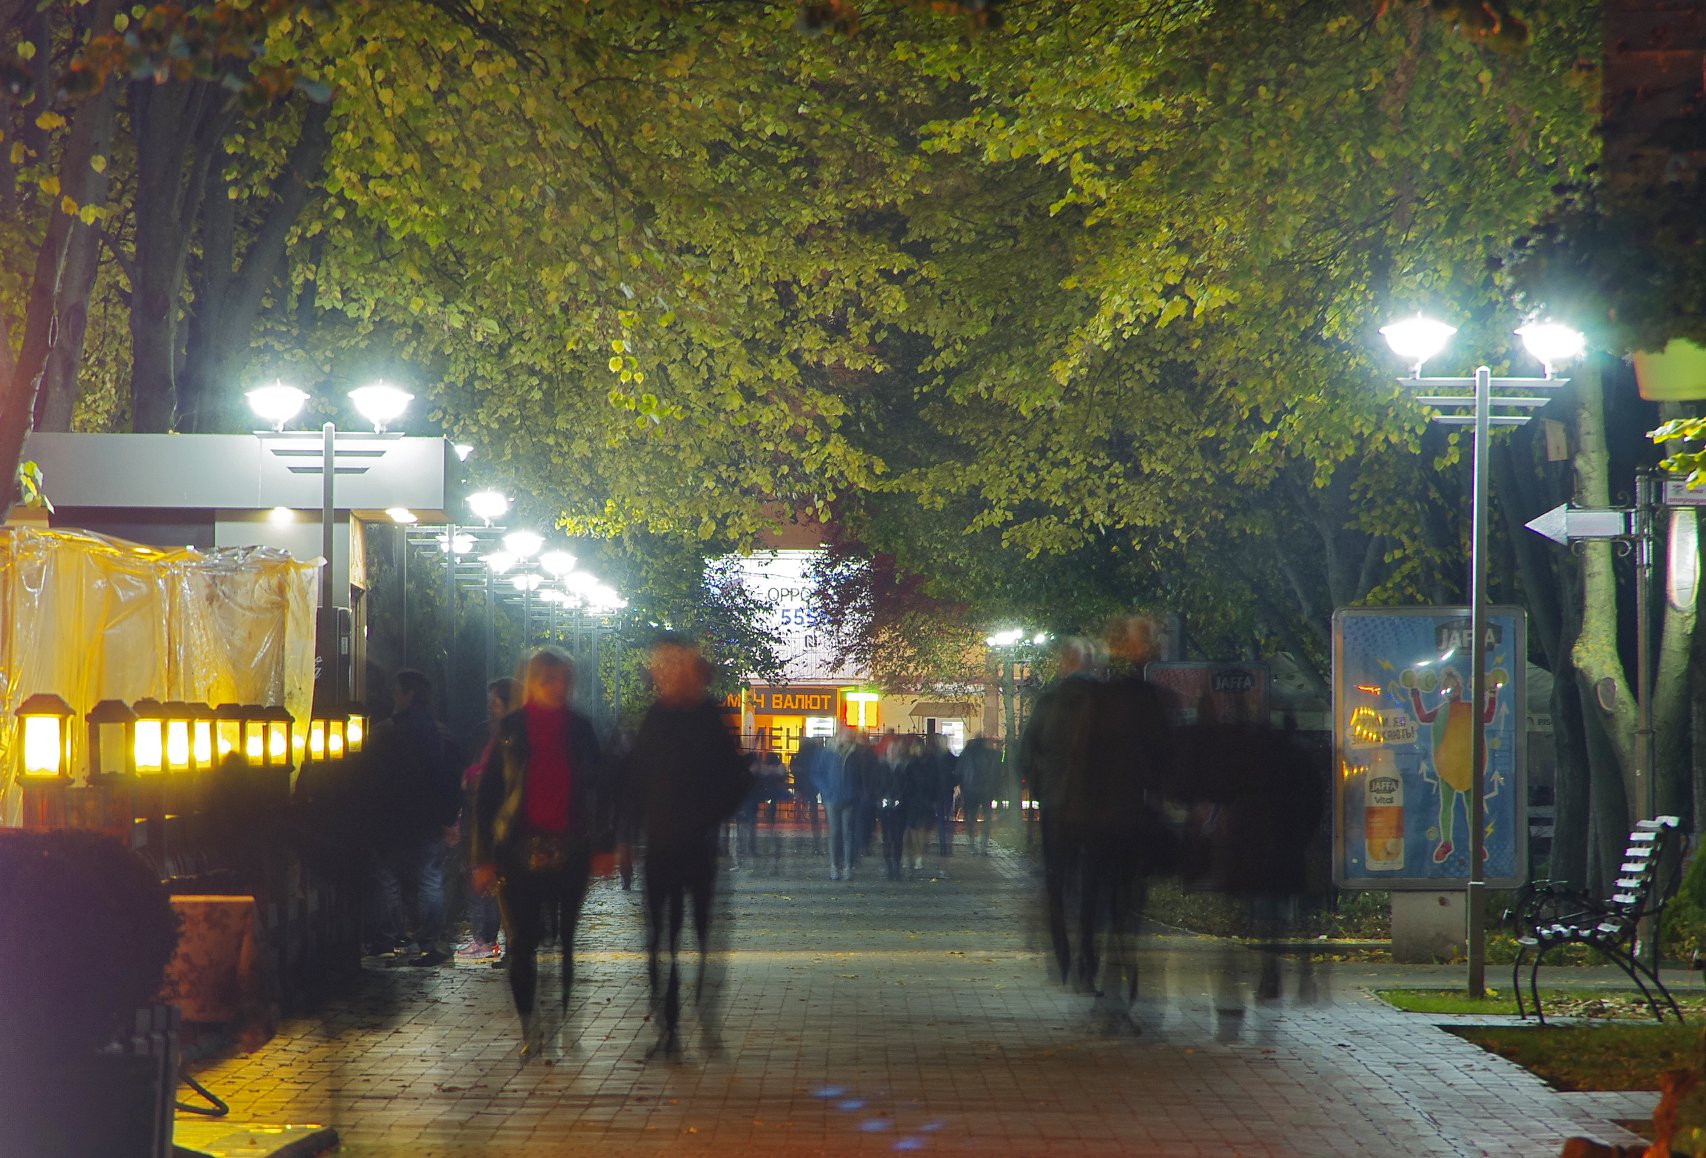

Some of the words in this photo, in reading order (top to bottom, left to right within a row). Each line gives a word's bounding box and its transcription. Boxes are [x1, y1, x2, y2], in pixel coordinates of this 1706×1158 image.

[767, 587, 812, 602] OPPO
[1439, 629, 1496, 650] JAFA
[1215, 676, 1253, 690] JAFFA
[771, 693, 832, 710] ВАЛЮТ
[1371, 781, 1398, 792] JAFFA
